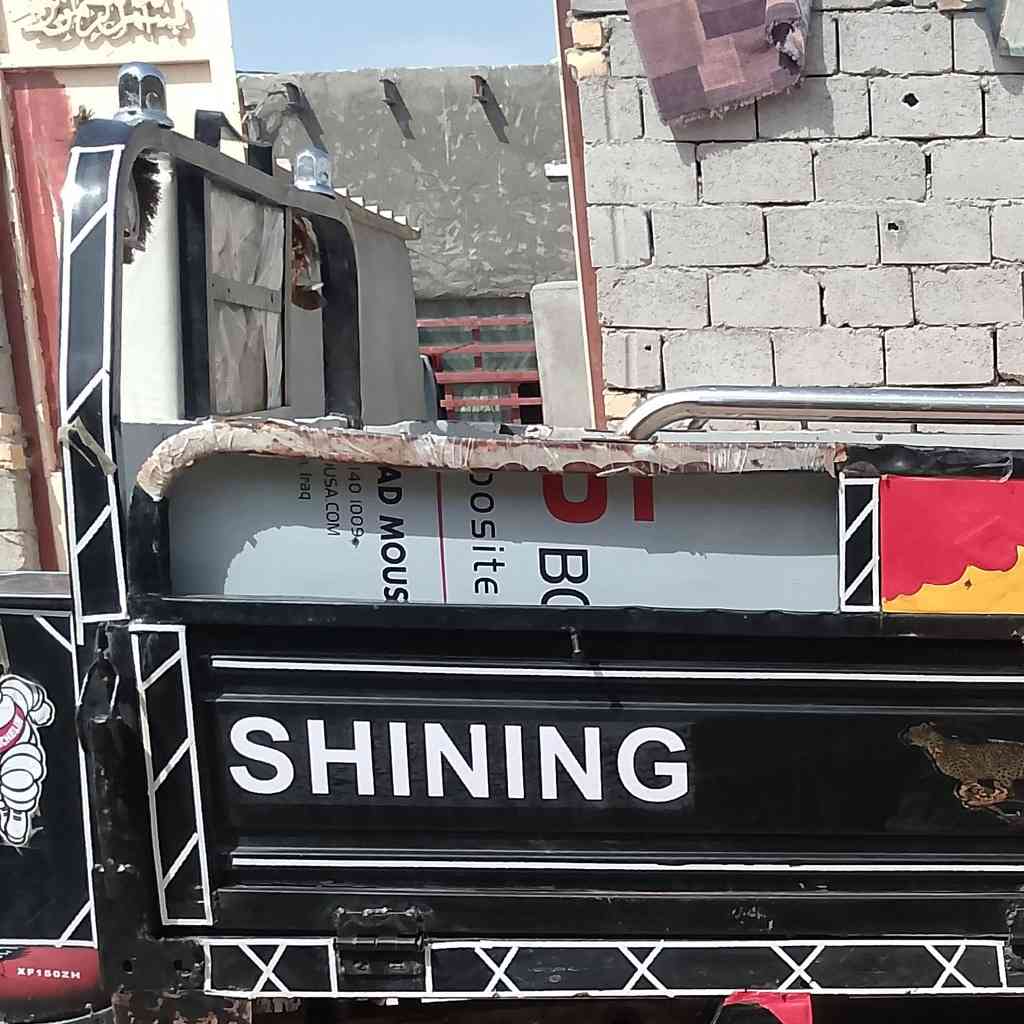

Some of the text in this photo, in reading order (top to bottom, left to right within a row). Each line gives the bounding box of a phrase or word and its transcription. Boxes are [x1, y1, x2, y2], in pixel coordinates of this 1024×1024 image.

[299, 472, 312, 499] Iraq
[229, 716, 688, 803] SHINING
[17, 967, 81, 979] XF150ZH
